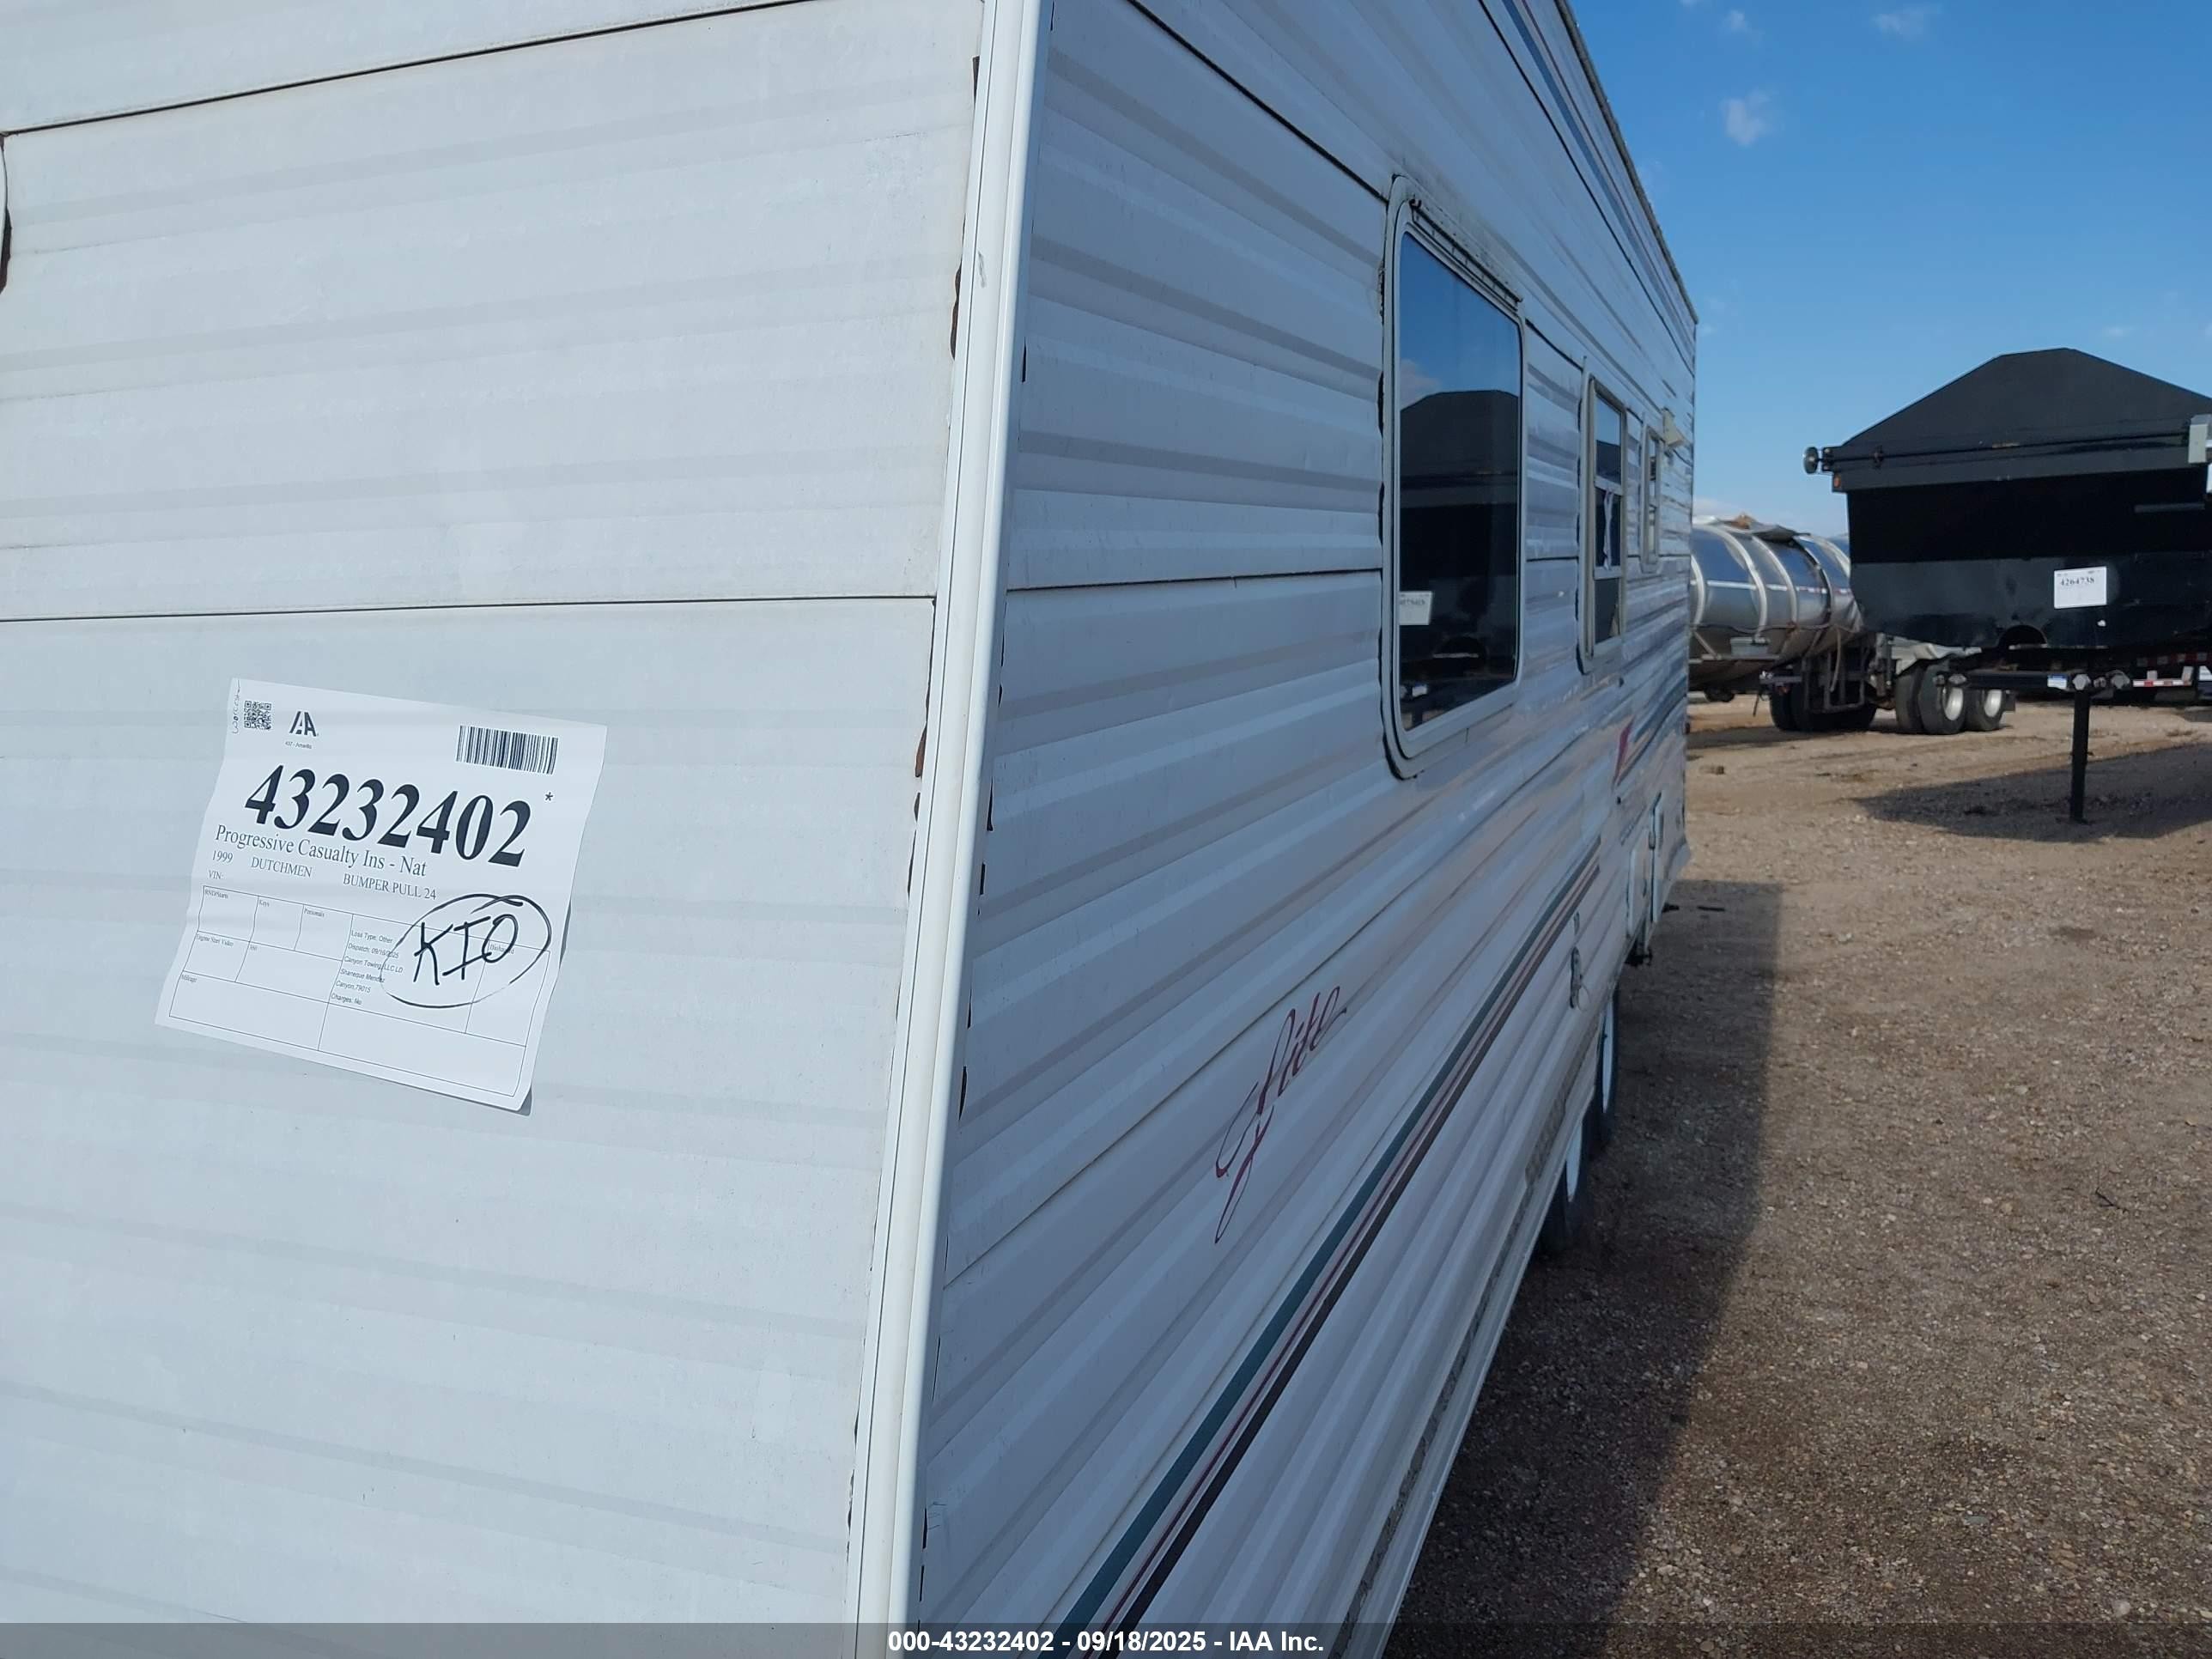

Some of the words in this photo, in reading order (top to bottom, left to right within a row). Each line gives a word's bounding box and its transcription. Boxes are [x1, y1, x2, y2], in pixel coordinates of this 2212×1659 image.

[244, 764, 532, 867] 43232402
[215, 824, 295, 854] Progressive
[298, 838, 360, 869] Casualty
[362, 849, 386, 870] Ins
[399, 855, 428, 878] Nat
[208, 869, 224, 881] VIN:
[212, 850, 234, 864] 1999
[251, 857, 313, 878] DUTCHMEN
[343, 873, 390, 894] BUMPER
[392, 884, 422, 899] PULL
[423, 888, 438, 901] 24
[378, 935, 393, 944] Other
[344, 956, 363, 966] Canyon
